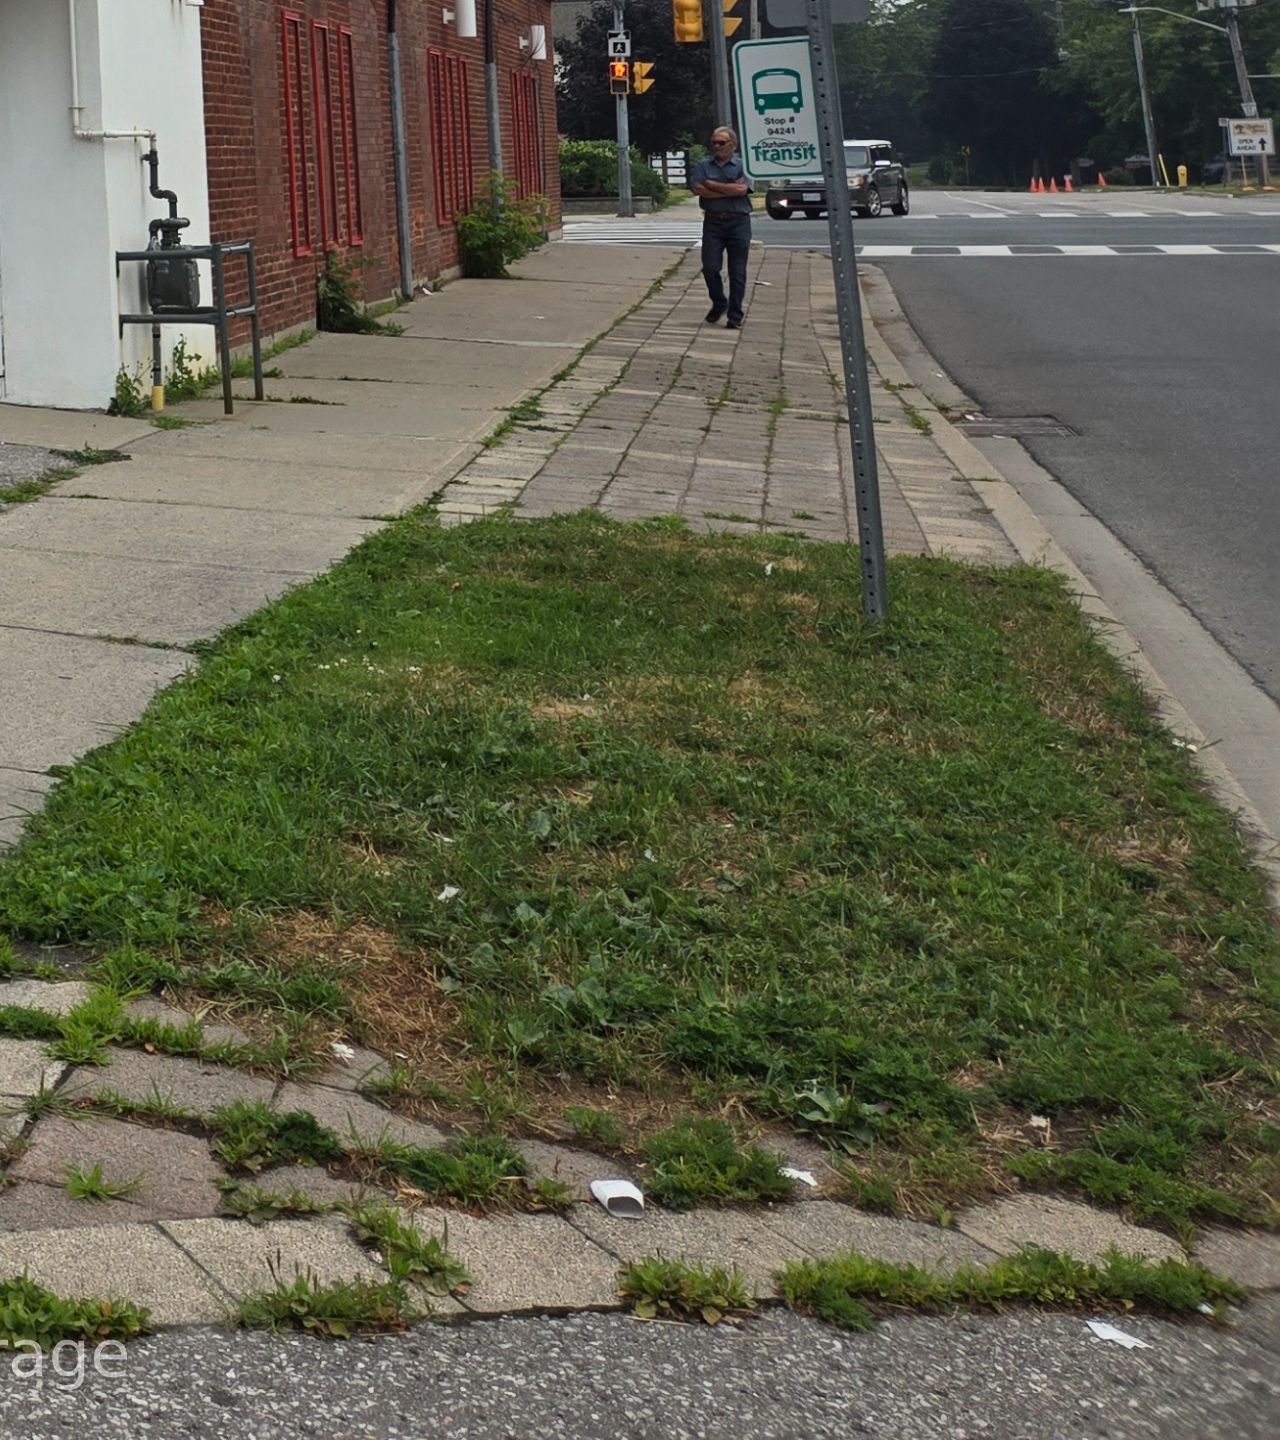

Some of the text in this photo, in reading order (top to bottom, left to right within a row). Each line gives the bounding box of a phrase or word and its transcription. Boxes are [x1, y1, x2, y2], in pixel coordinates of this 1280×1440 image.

[764, 117, 786, 125] Stop
[767, 127, 795, 136] 94241
[751, 144, 817, 162] Transit
